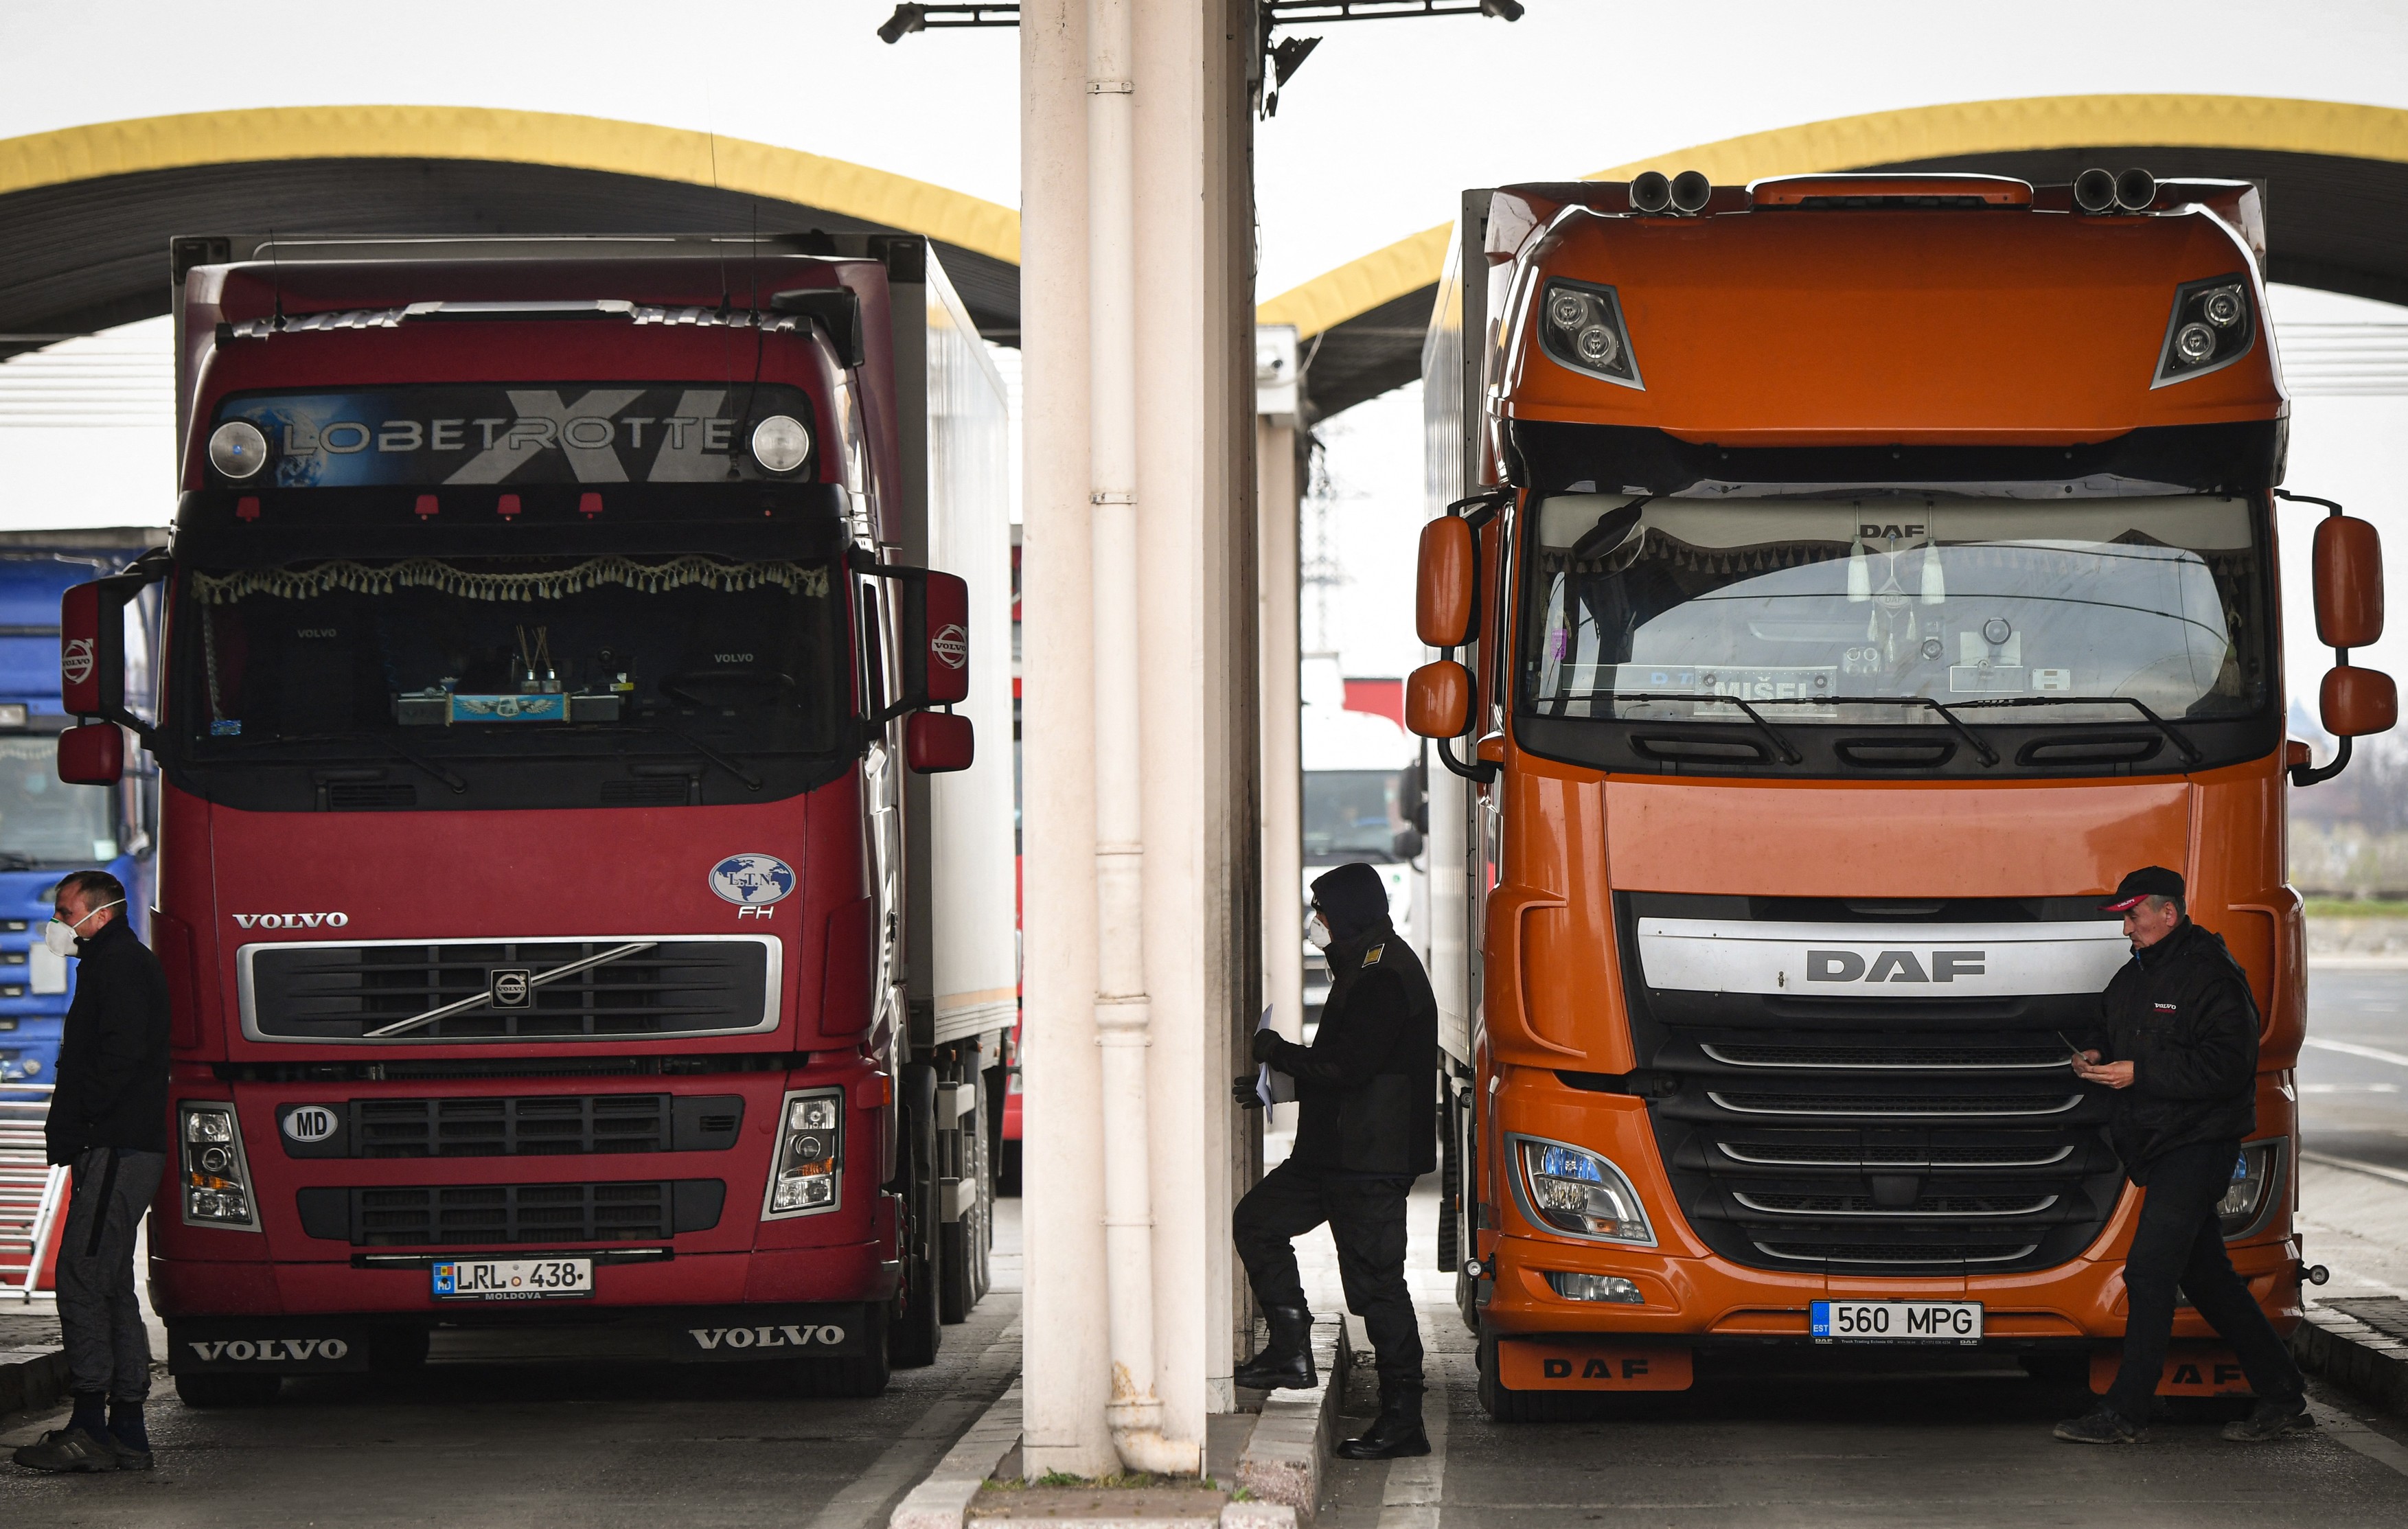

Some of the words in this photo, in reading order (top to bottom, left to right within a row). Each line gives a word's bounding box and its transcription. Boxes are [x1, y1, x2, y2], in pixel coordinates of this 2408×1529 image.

[283, 416, 739, 456] LOBETROTTE
[1859, 524, 1925, 538] DAF
[297, 628, 336, 638] VOLVO
[934, 642, 967, 652] VOLVO
[714, 654, 754, 663] VOLVO
[728, 872, 776, 886] L.T.N.
[2118, 899, 2135, 908] HILTI
[231, 911, 349, 929] VOLVO
[737, 905, 775, 920] FH
[1807, 950, 1985, 982] DAF
[297, 1112, 328, 1136] MD
[457, 1265, 507, 1290] LRL
[530, 1262, 577, 1289] 438
[437, 1280, 451, 1290] MD
[485, 1291, 542, 1301] MOLDOVA
[1813, 1324, 1828, 1333] EST
[1838, 1307, 1890, 1333] 560
[1907, 1307, 1973, 1335] MPG
[689, 1325, 845, 1349] VOLVO
[188, 1339, 348, 1361] VOLVO
[1544, 1359, 1649, 1379] DAF
[2171, 1364, 2242, 1385] AF
